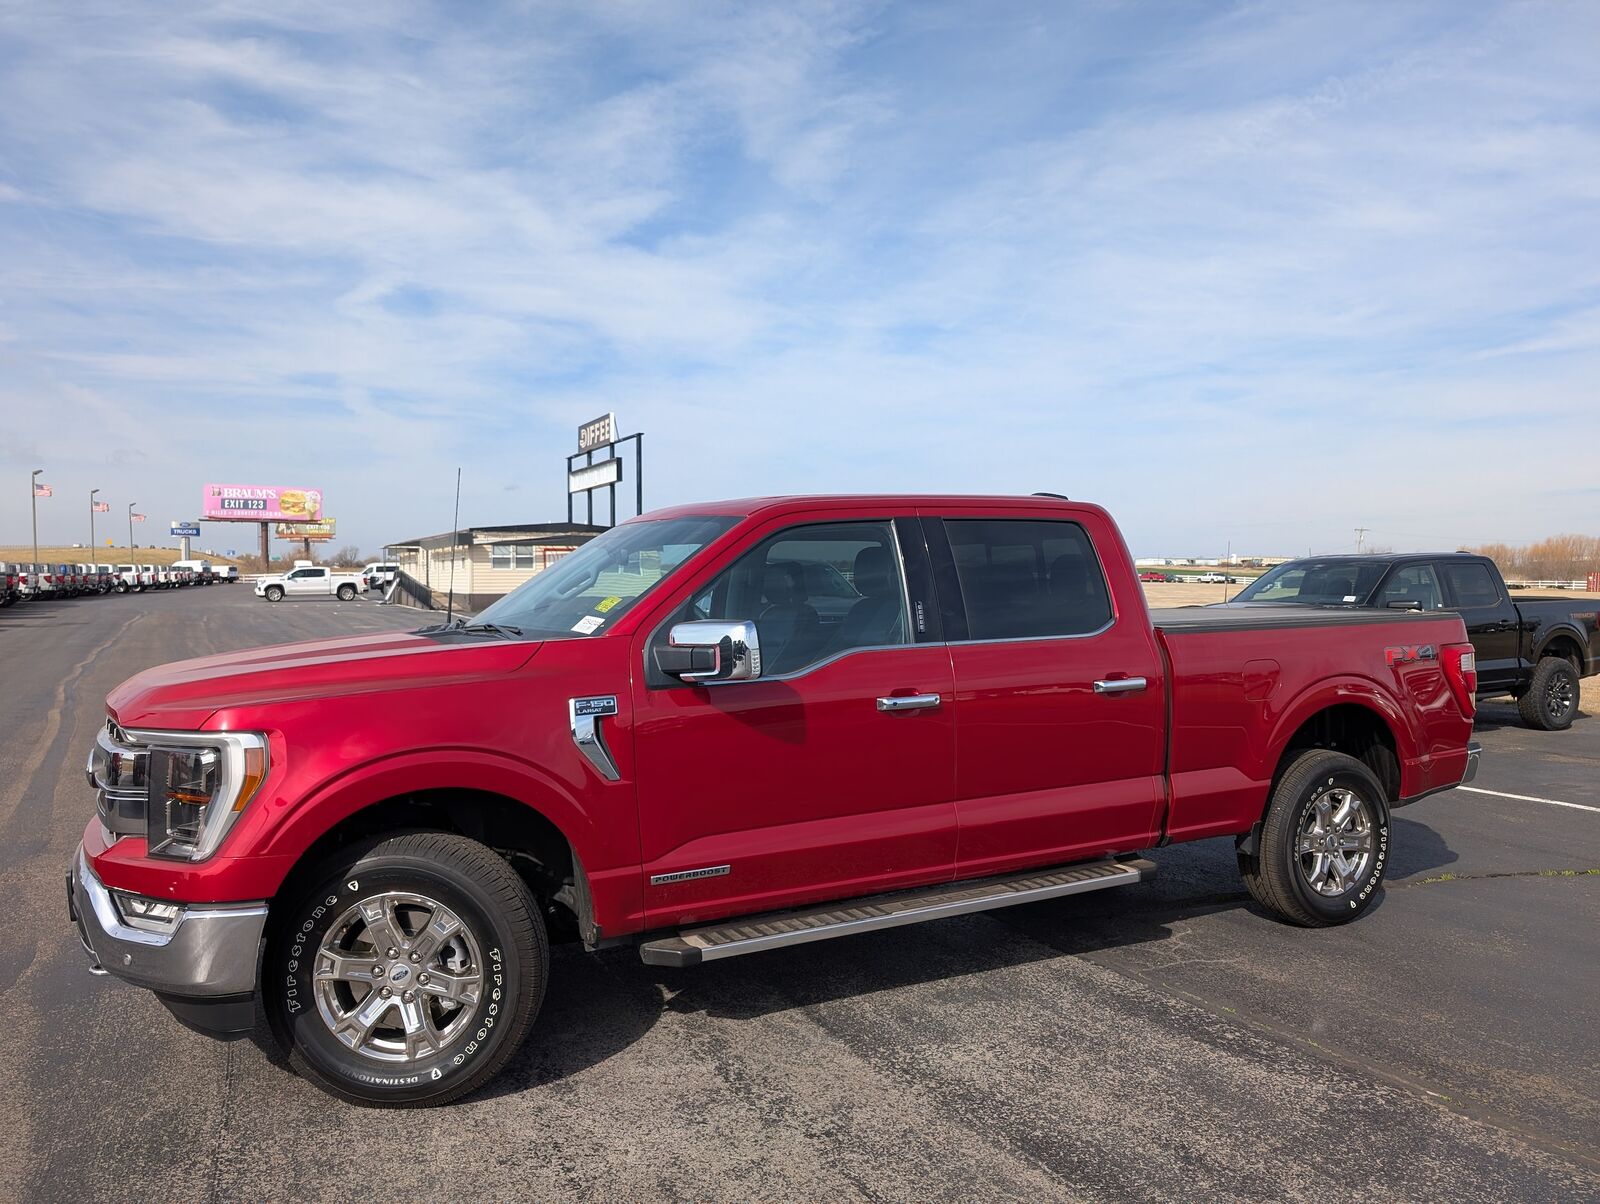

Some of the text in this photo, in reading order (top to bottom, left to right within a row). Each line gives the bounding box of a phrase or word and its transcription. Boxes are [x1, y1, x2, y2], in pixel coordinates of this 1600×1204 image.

[223, 487, 277, 499] BRAUM'S
[224, 499, 264, 509] EXIT 123
[1384, 645, 1436, 668] FX4
[575, 699, 615, 709] F-150
[653, 866, 727, 883] POWERBOOST
[287, 895, 338, 1013] Firestone
[453, 948, 502, 1065] Firestone
[351, 1070, 418, 1085] DESTINATION
